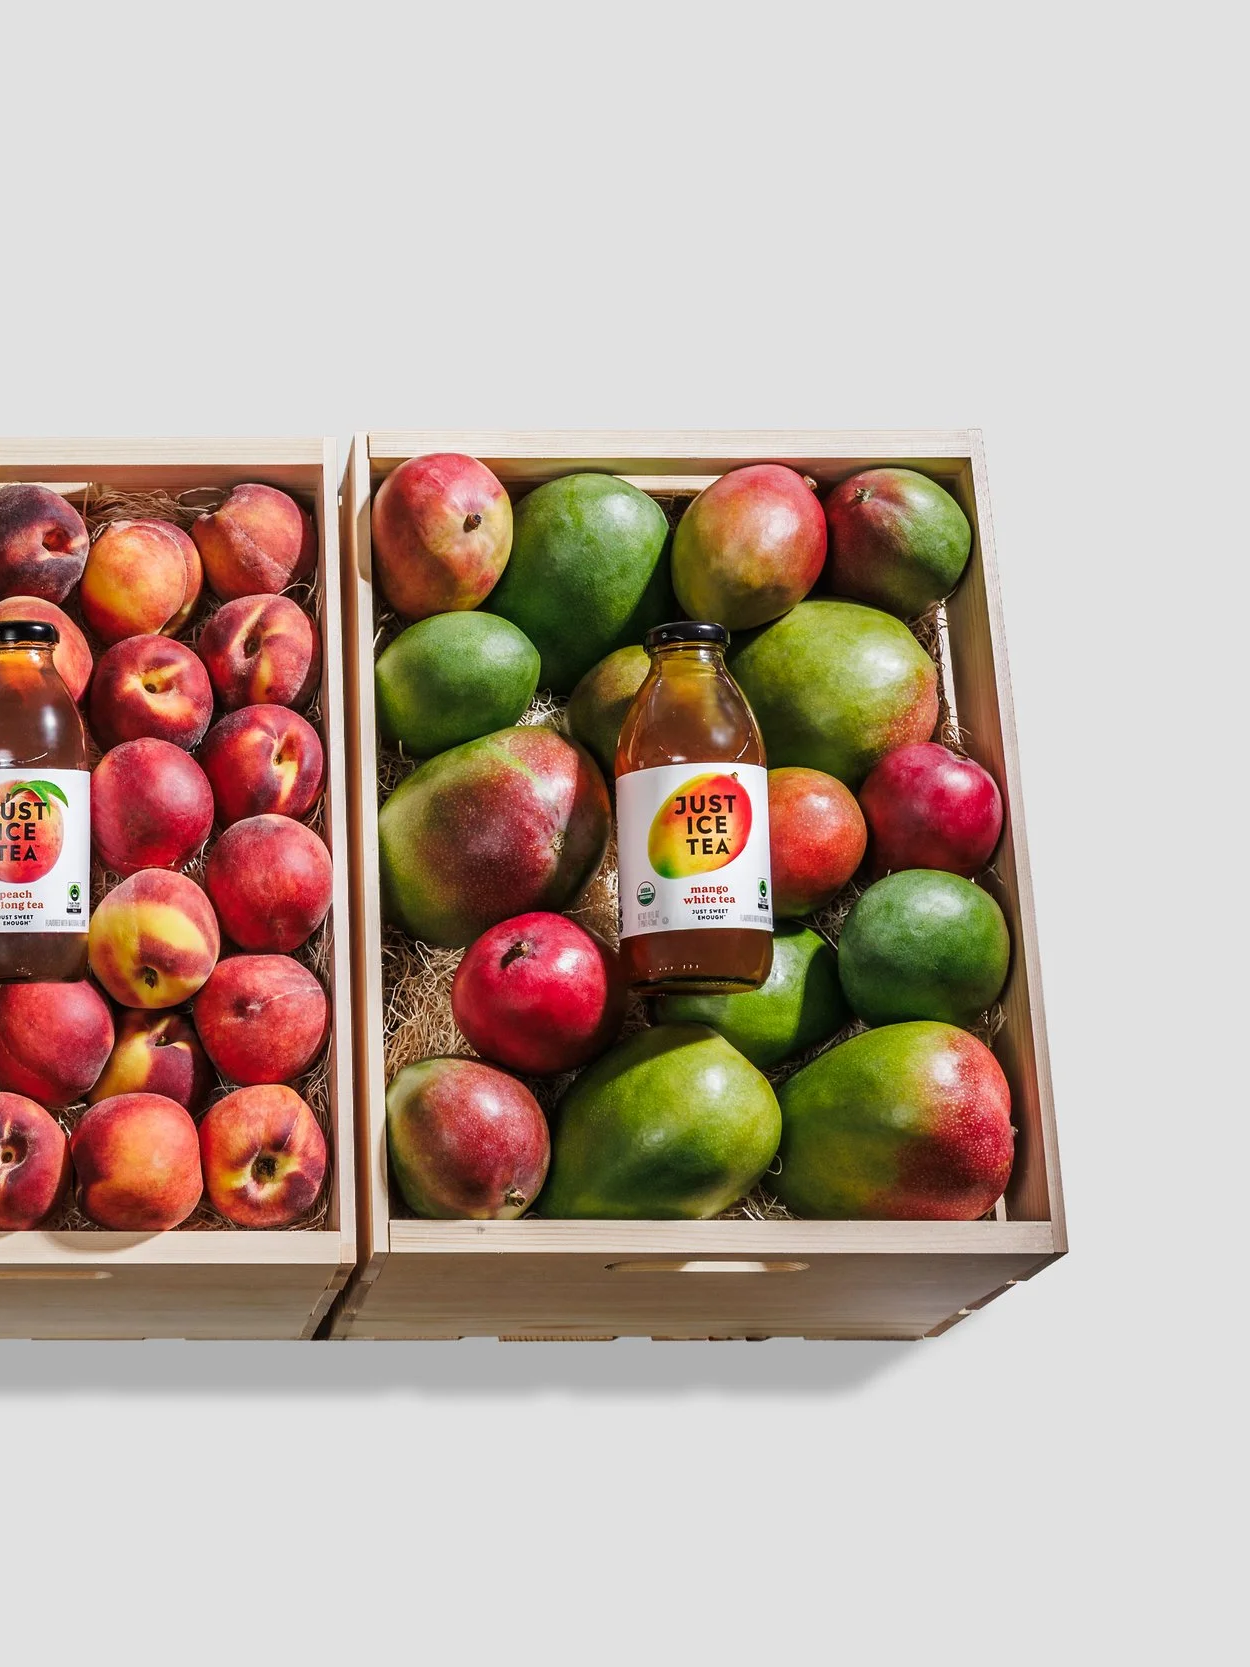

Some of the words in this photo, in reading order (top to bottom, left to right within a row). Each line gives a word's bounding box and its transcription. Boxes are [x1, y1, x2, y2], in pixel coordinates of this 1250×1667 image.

[674, 795, 736, 815] JUST
[687, 816, 727, 835] ICE
[0, 889, 32, 900] peach
[690, 885, 729, 895] mango
[27, 901, 44, 909] tea
[683, 894, 717, 905] white
[718, 895, 736, 904] tea
